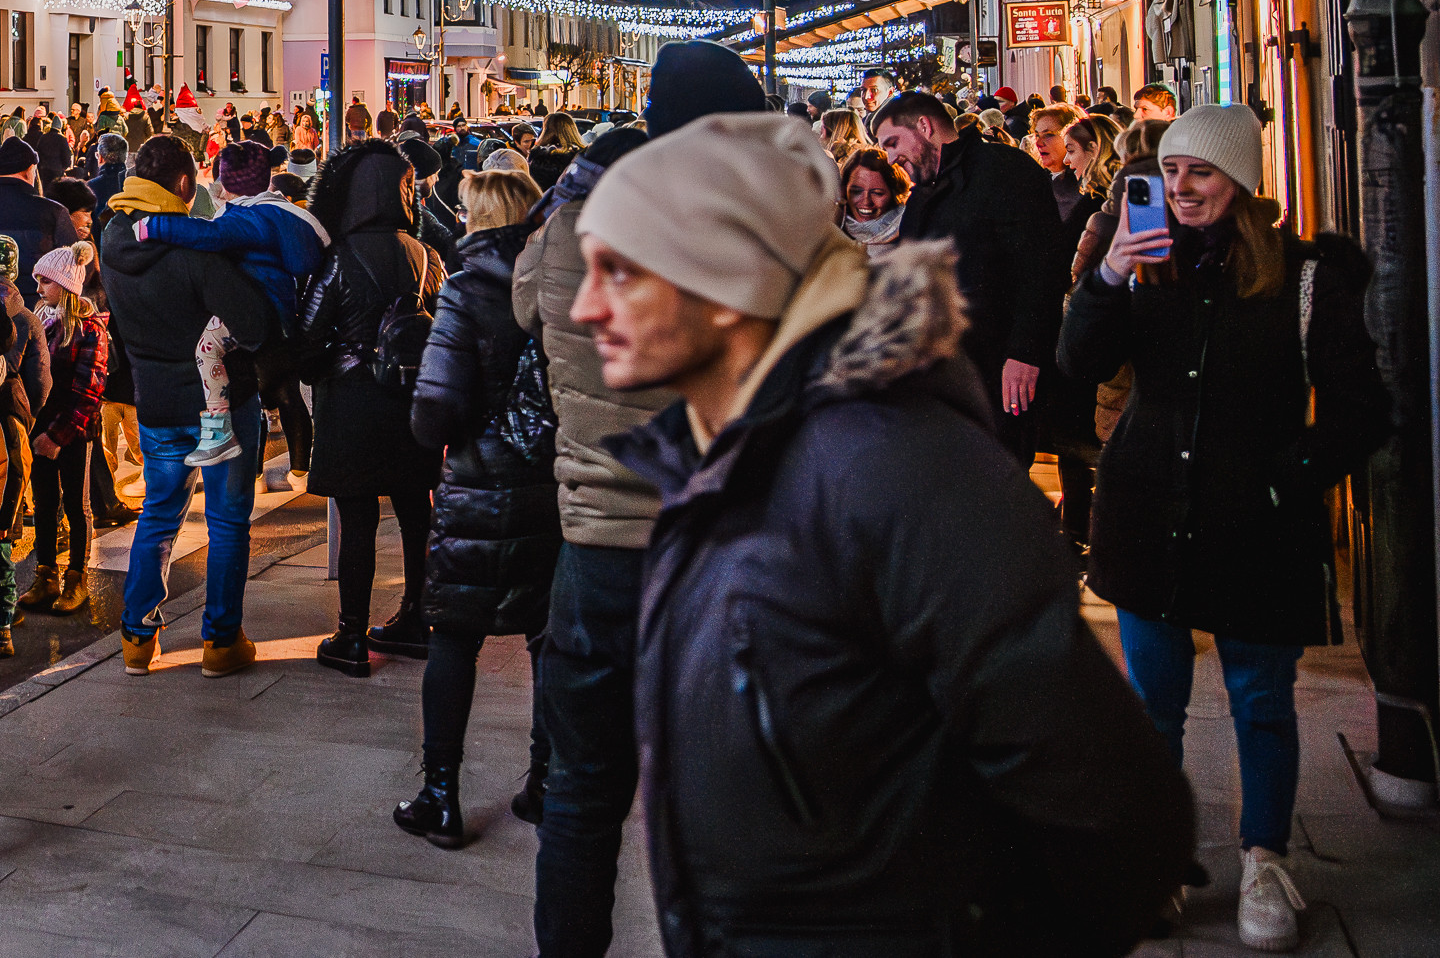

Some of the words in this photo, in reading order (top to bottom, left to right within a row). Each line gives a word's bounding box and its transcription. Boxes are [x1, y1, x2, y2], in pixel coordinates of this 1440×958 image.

[1012, 8, 1037, 17] Santa
[1038, 7, 1063, 16] Lucia
[323, 57, 329, 75] P
